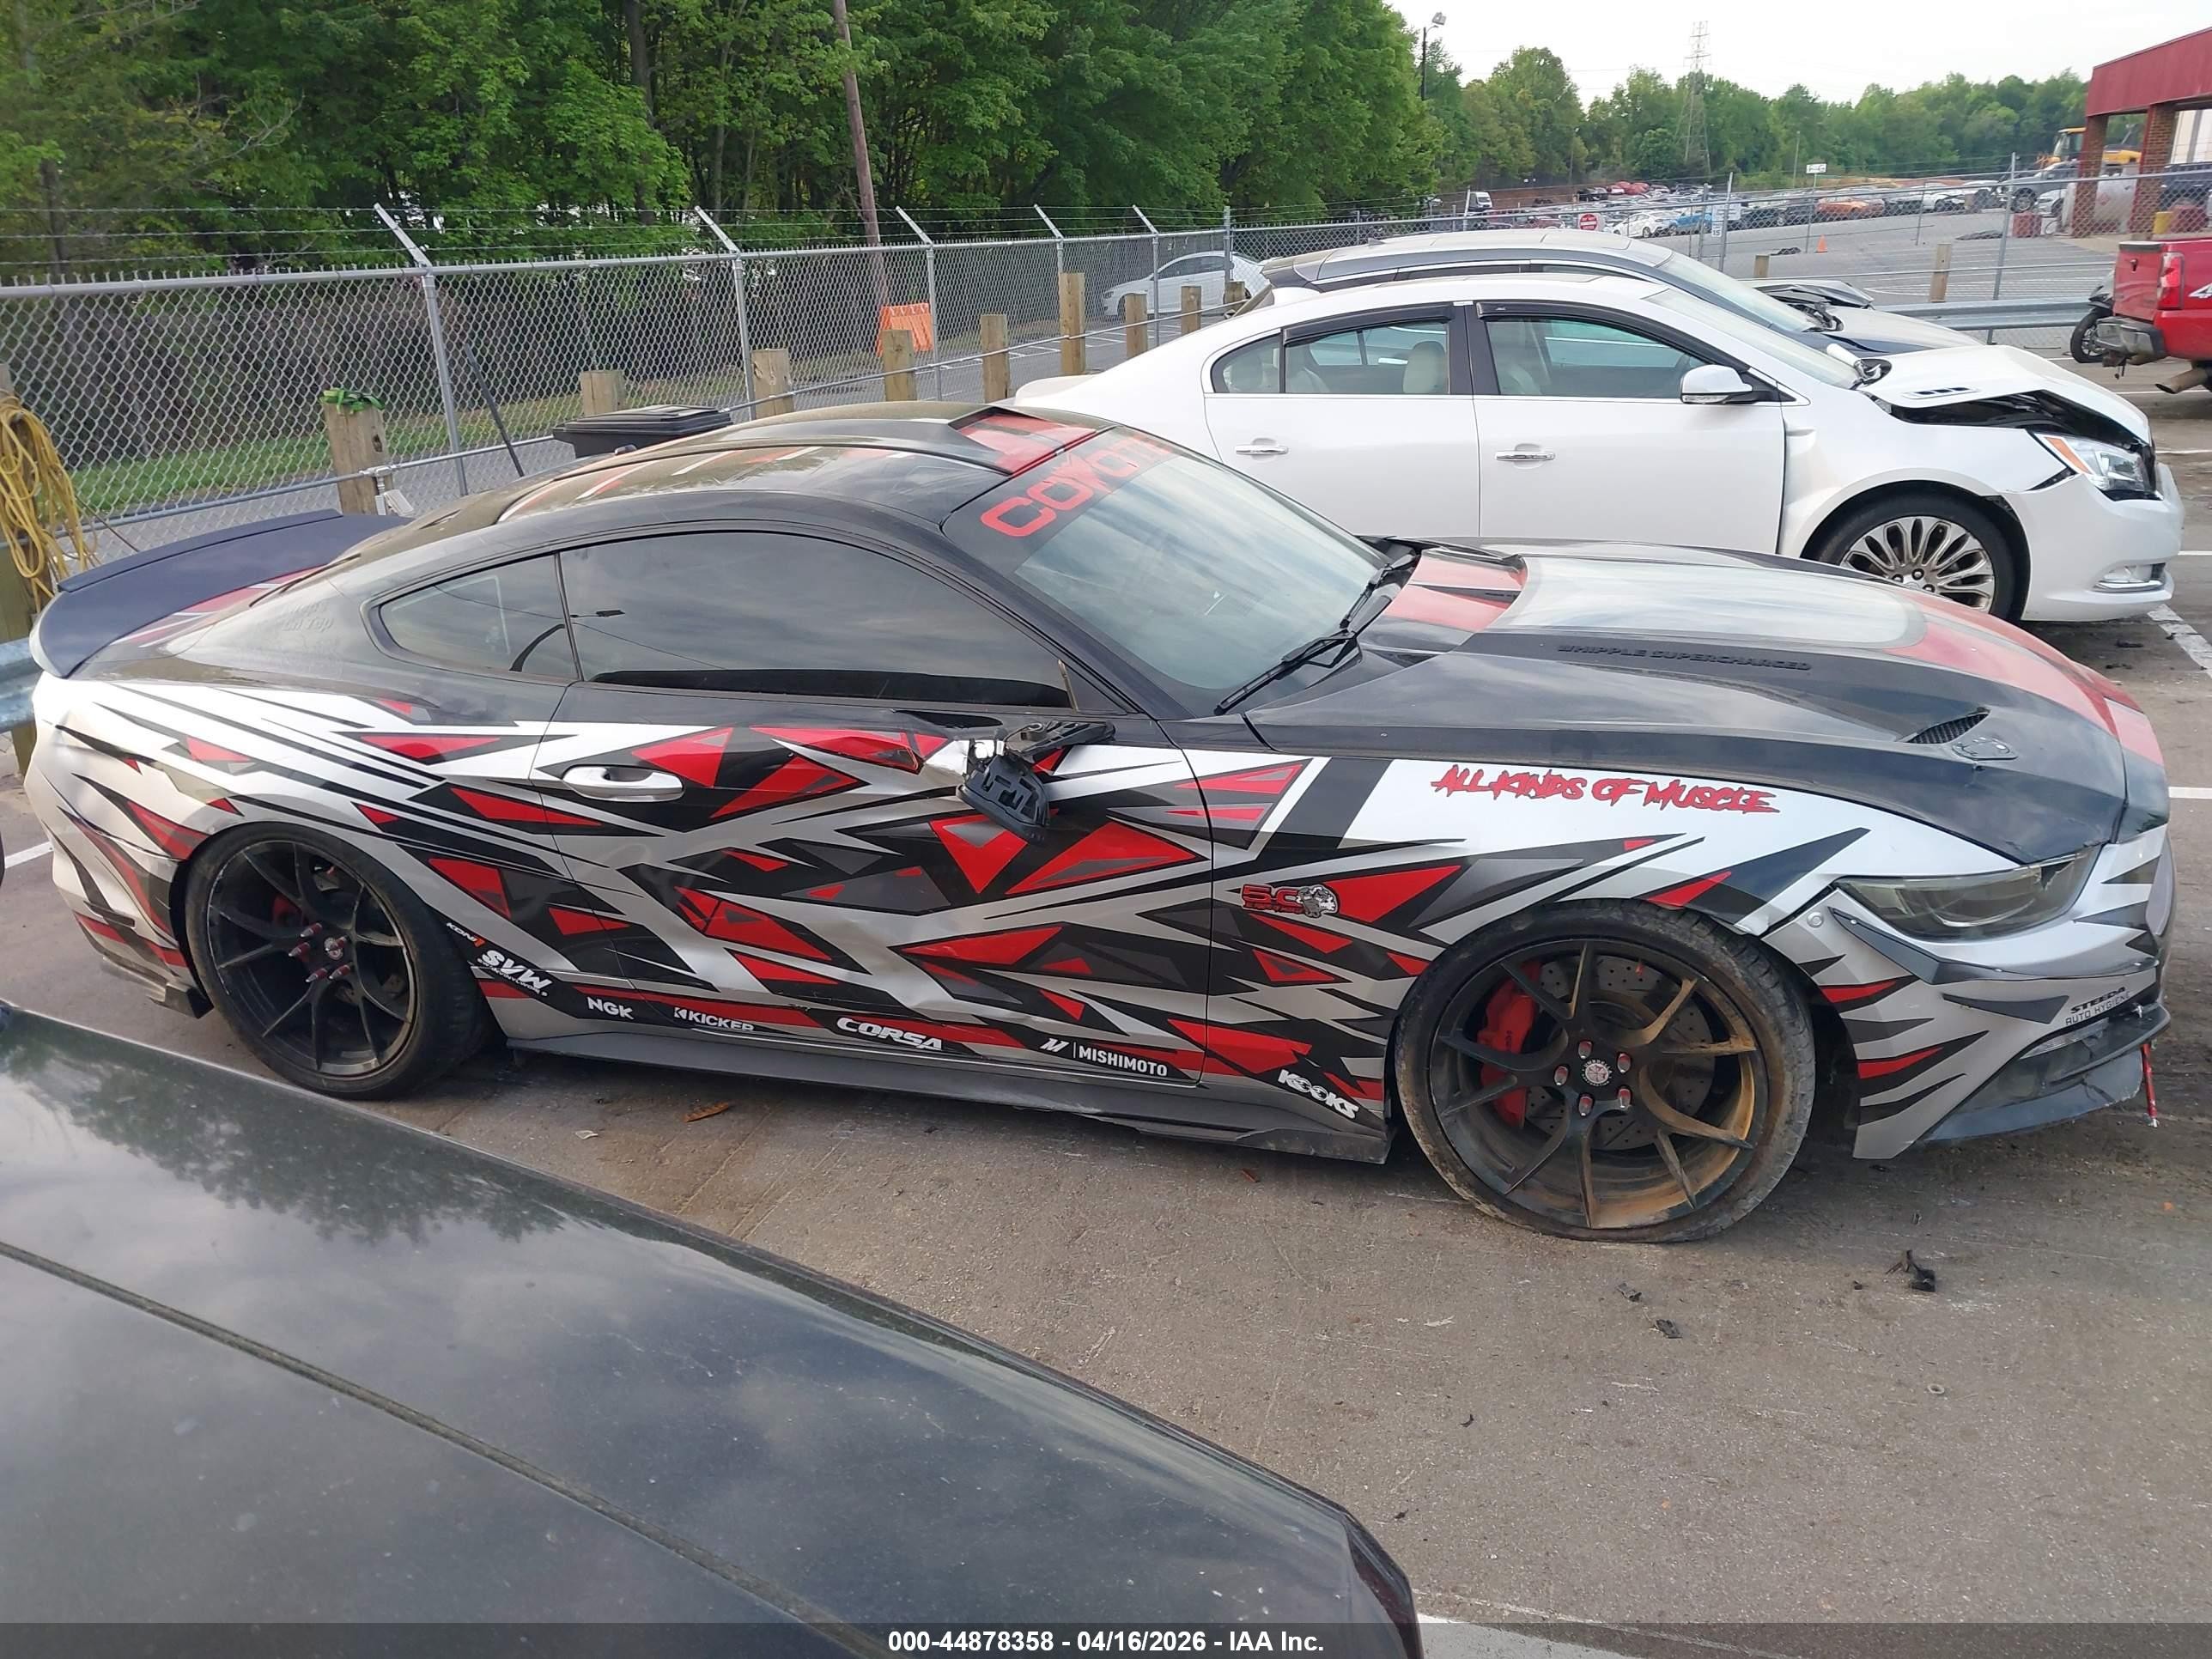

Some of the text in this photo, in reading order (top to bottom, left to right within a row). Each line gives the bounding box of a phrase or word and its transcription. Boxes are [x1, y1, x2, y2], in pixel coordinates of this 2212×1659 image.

[1557, 644, 1812, 672] WHIPPLE SUPERCHARGED
[1431, 764, 1781, 814] ALL KINDS OF MUSCLE
[446, 921, 480, 944] KONI
[587, 996, 635, 1021] NGK
[2070, 987, 2126, 1013] STEEDA
[688, 1011, 756, 1031] KICKER
[2065, 1010, 2092, 1026] AUTO
[836, 1017, 943, 1051] CORSA
[1078, 1044, 1168, 1077] MISHIMOTO
[1277, 1068, 1360, 1120] KOOKS
